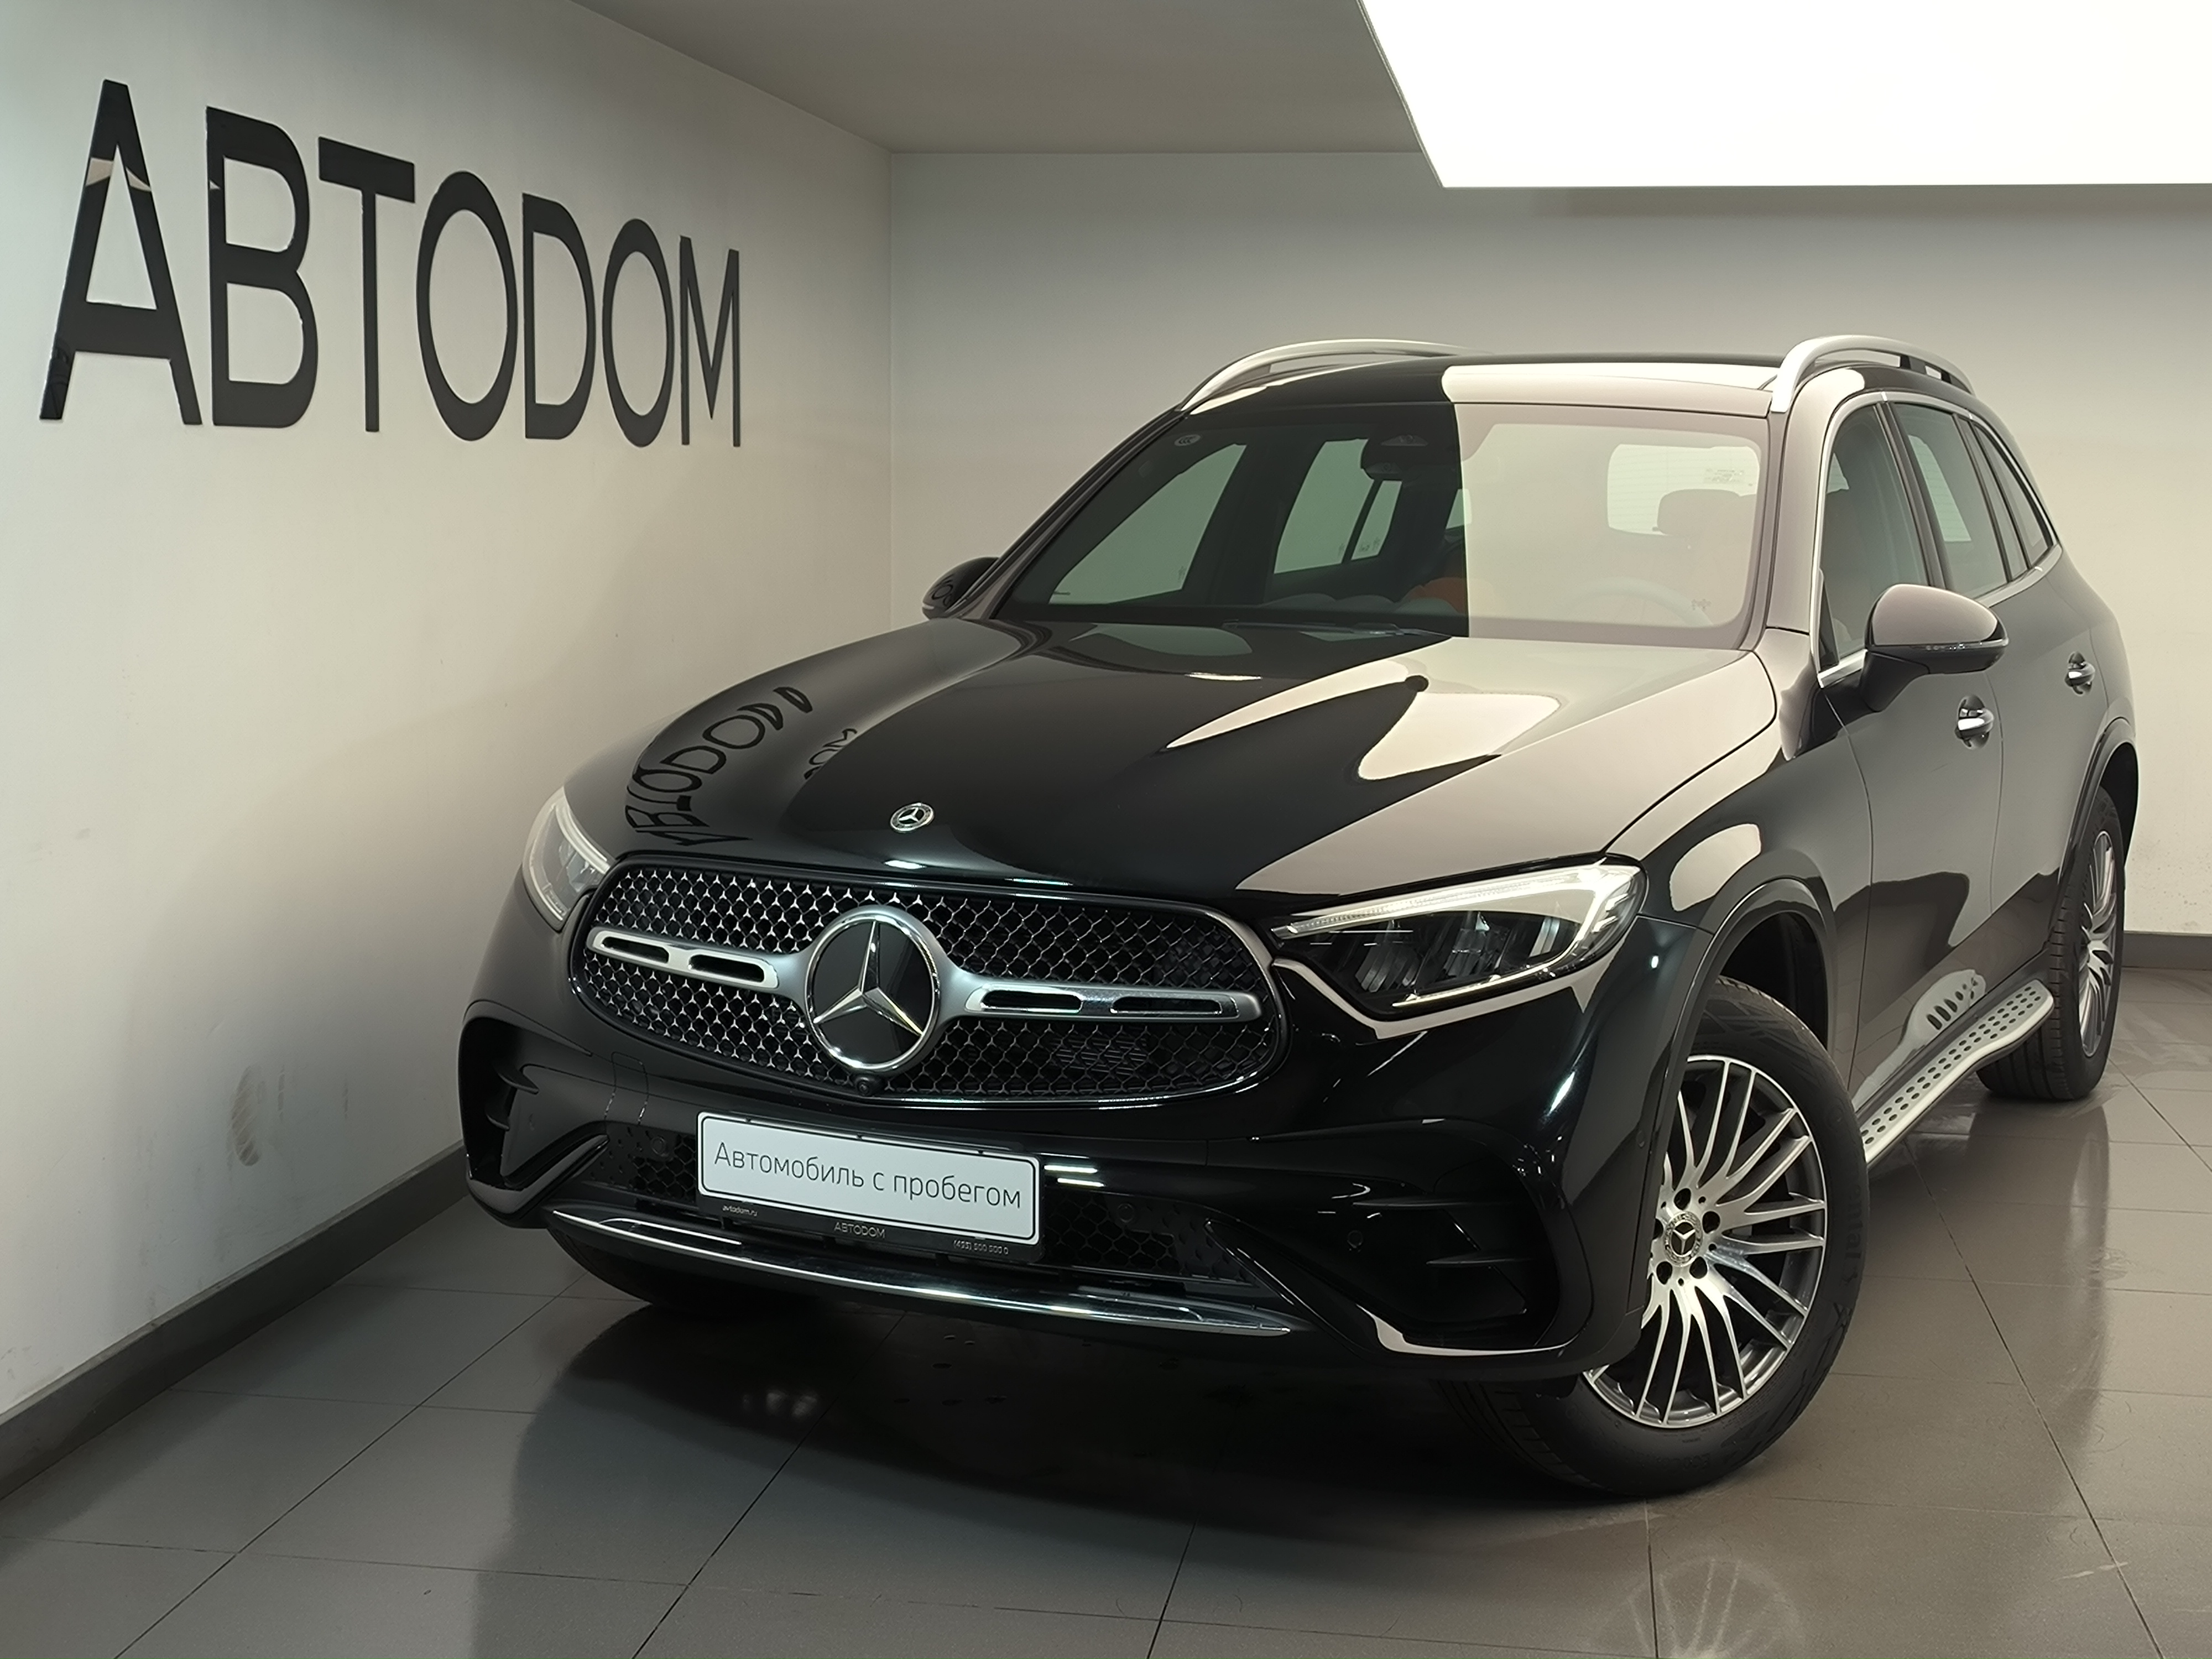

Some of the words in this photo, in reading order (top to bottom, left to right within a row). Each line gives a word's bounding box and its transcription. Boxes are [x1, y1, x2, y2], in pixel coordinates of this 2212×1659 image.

[714, 1141, 865, 1188] Автомобиль
[873, 1172, 885, 1191] с
[893, 1174, 1021, 1209] пробегом
[722, 1205, 758, 1217] avtodom.ru
